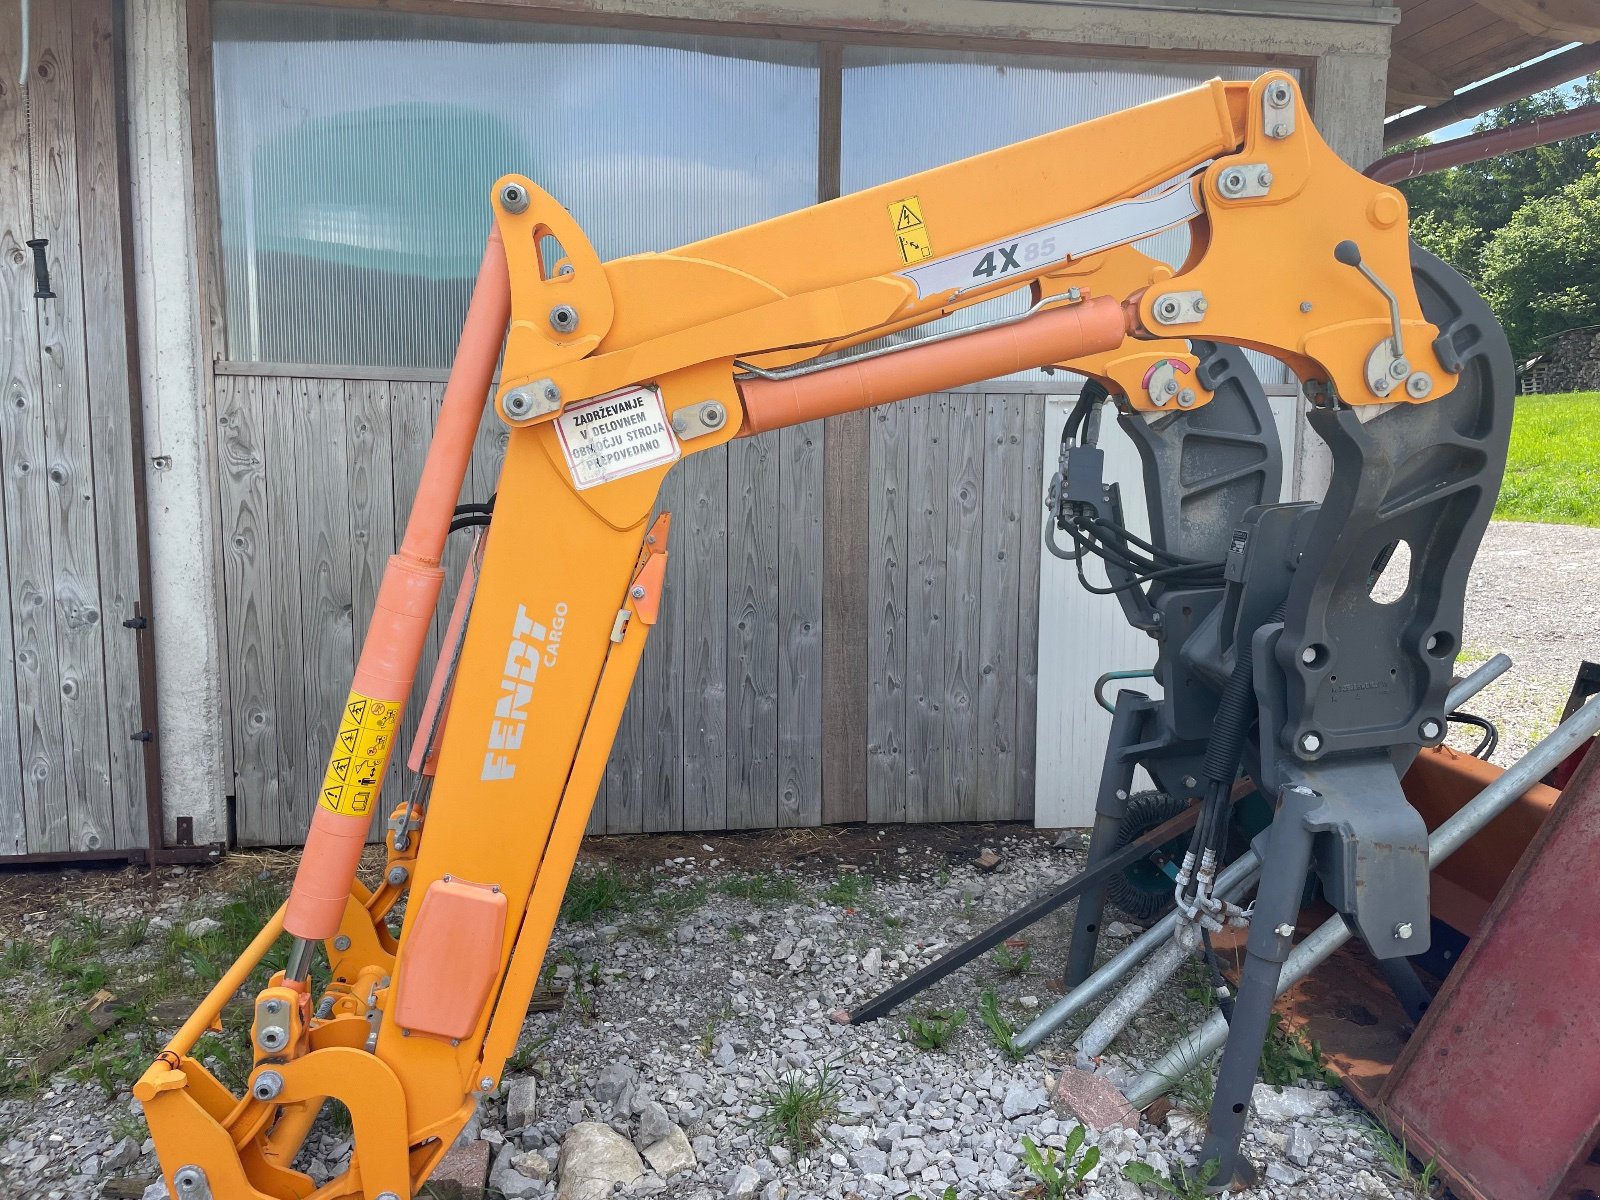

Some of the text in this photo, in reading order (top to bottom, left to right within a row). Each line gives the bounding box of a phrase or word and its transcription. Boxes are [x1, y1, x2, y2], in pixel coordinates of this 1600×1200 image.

[572, 396, 645, 427] ZADRŽEVANJE
[580, 411, 647, 440] V DELOVNEM
[626, 421, 665, 442] STROJA
[543, 602, 569, 668] CARGO
[480, 603, 547, 781] FENDT
